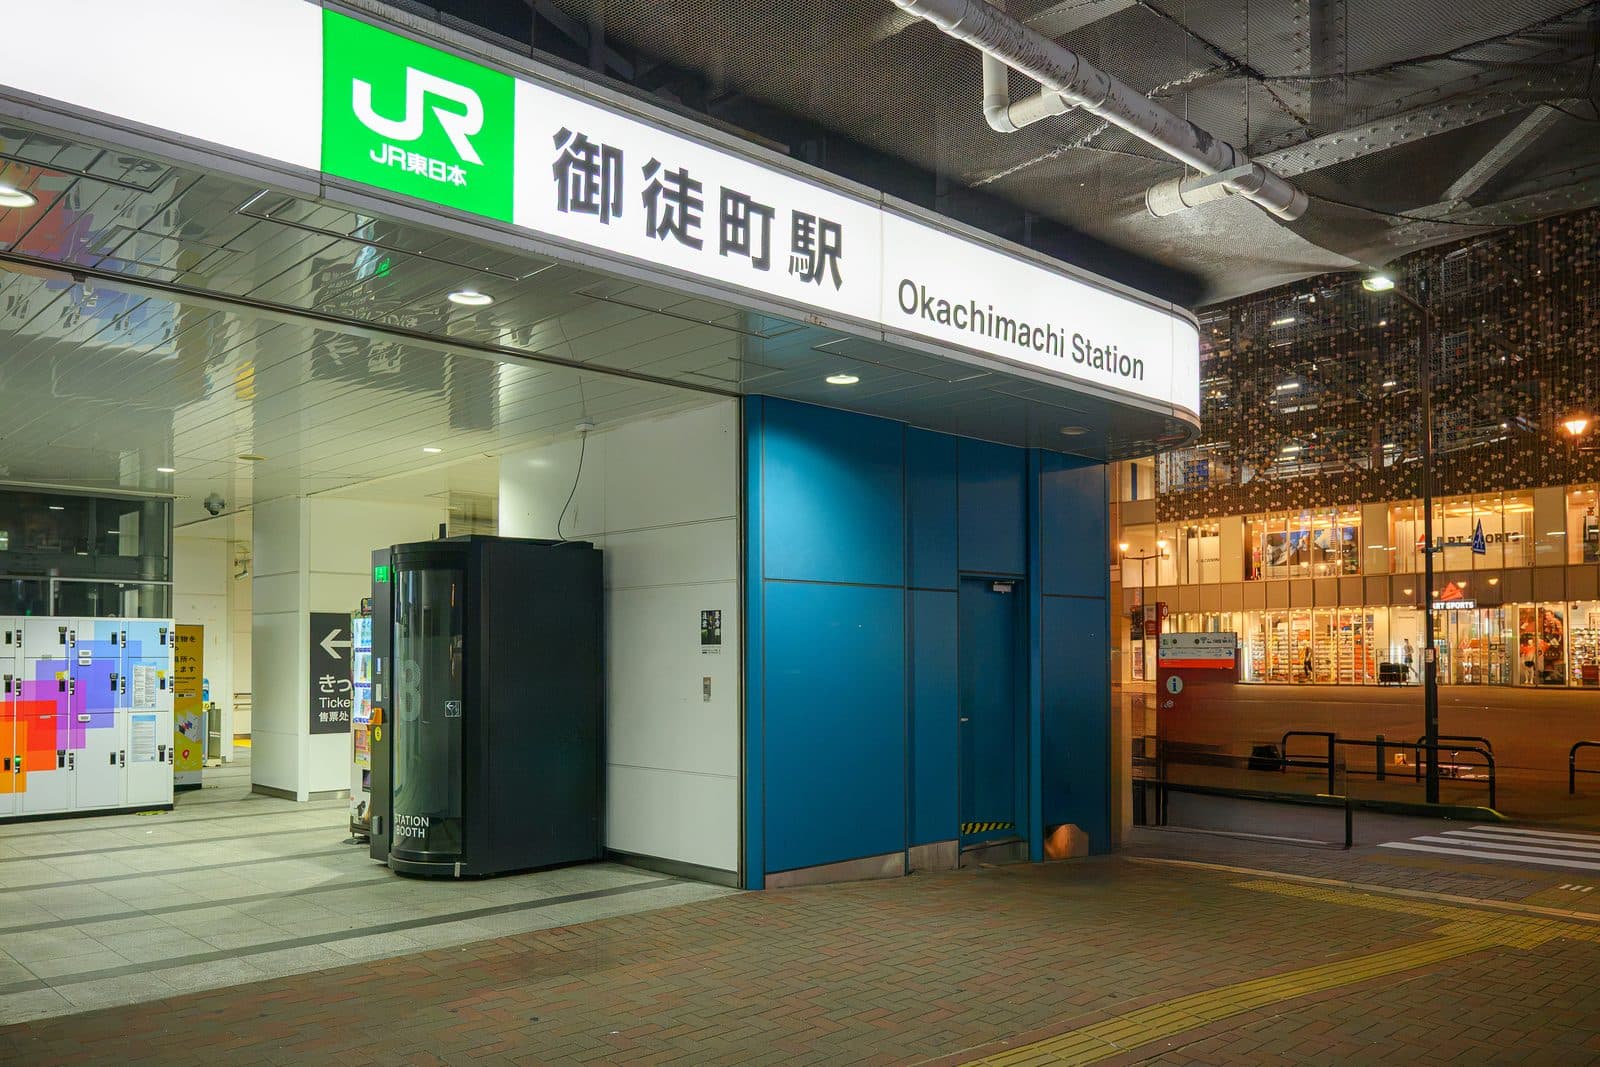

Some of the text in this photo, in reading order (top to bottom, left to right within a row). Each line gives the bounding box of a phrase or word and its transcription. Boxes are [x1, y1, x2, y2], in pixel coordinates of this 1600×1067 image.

[352, 66, 484, 166] JR
[369, 143, 468, 187] JR東日本
[552, 126, 843, 292] 御徒町駅
[898, 278, 1145, 381] Okachimachi Station
[318, 710, 349, 722] 售票处
